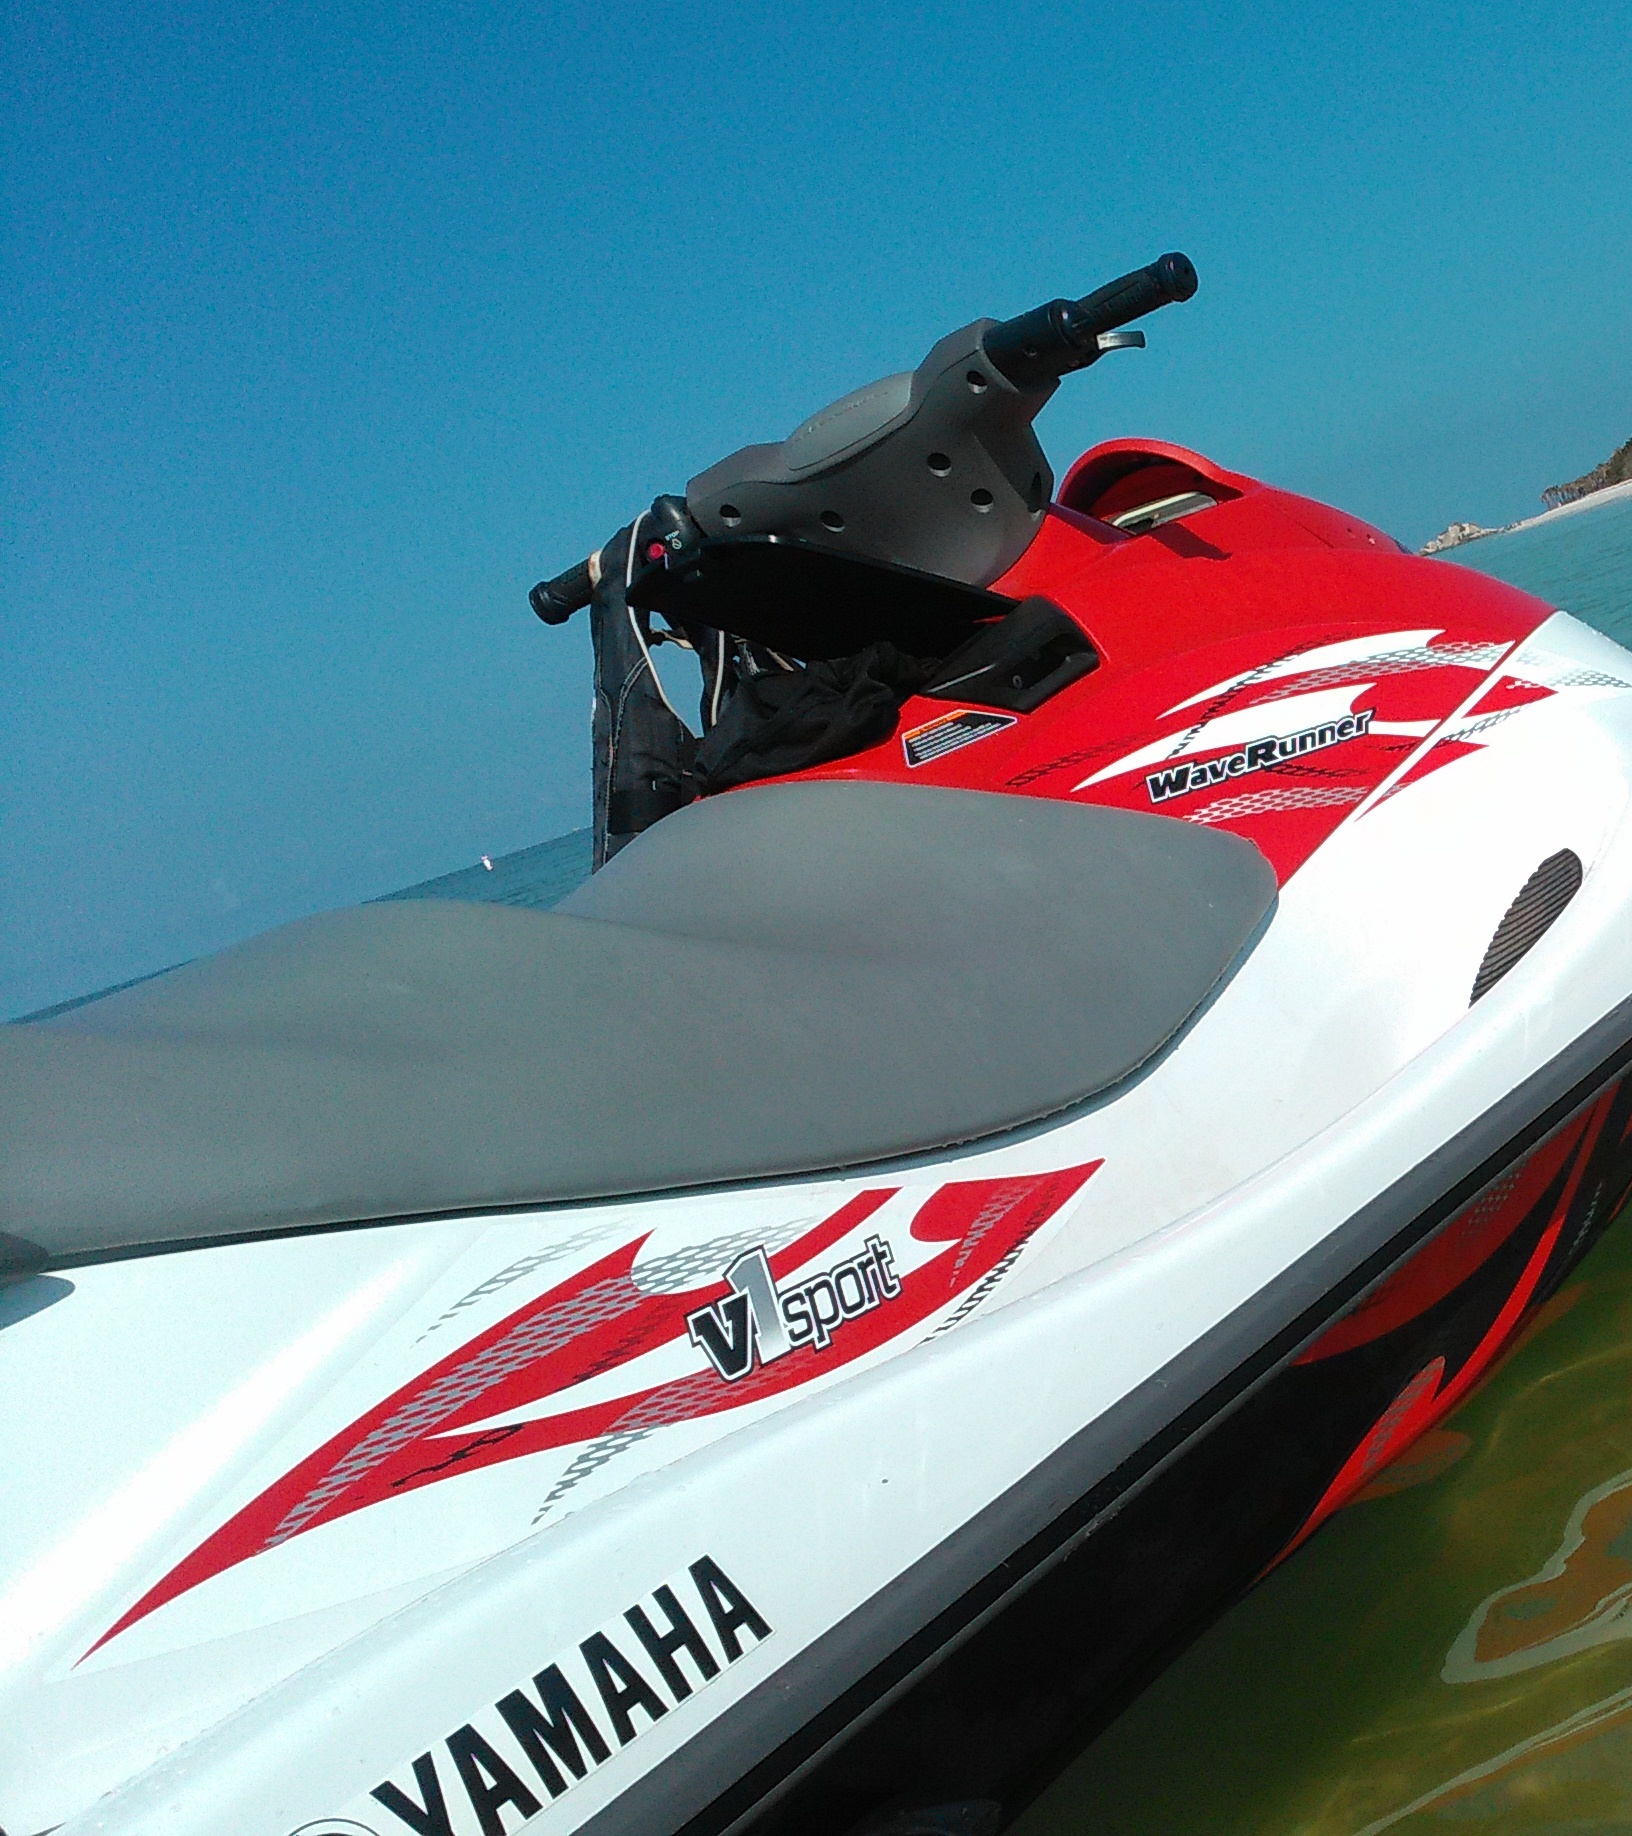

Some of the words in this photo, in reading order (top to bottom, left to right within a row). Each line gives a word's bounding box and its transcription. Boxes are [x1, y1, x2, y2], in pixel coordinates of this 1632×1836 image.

[1147, 707, 1376, 803] WaveRunner
[780, 1236, 901, 1351] sport
[369, 1554, 774, 1836] YAMAHA
